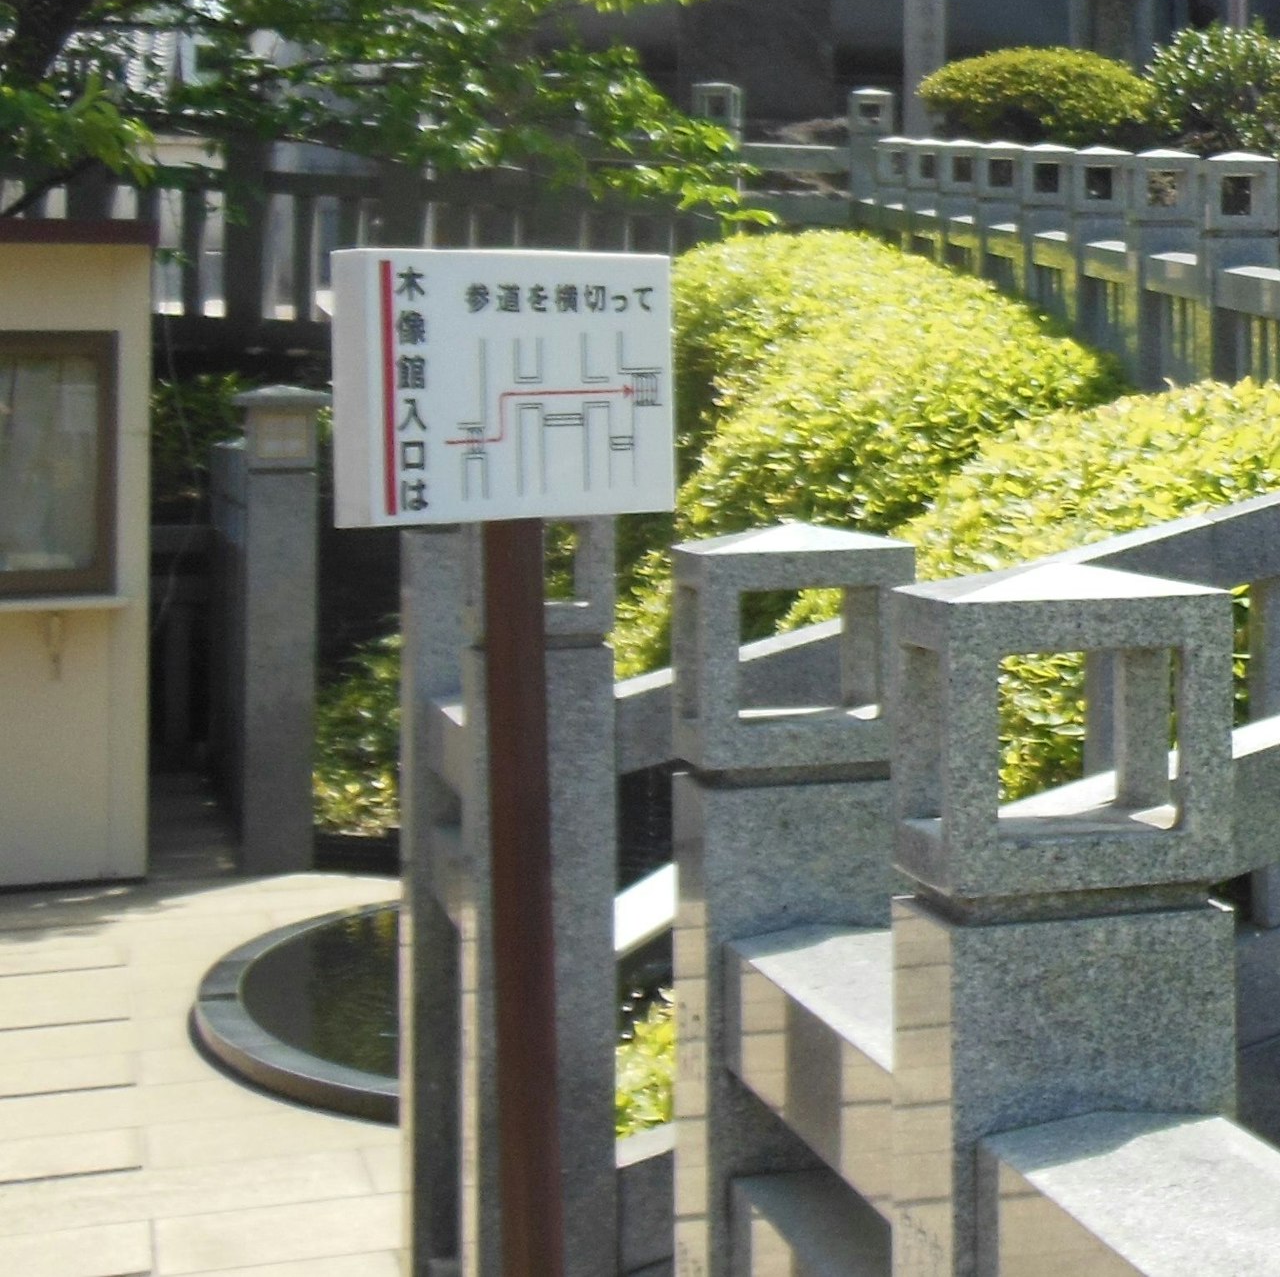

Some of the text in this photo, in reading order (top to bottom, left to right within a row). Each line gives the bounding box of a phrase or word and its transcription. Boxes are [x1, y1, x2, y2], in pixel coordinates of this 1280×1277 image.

[465, 283, 654, 314] 参道を横切って
[394, 265, 428, 512] 木像館入口は
